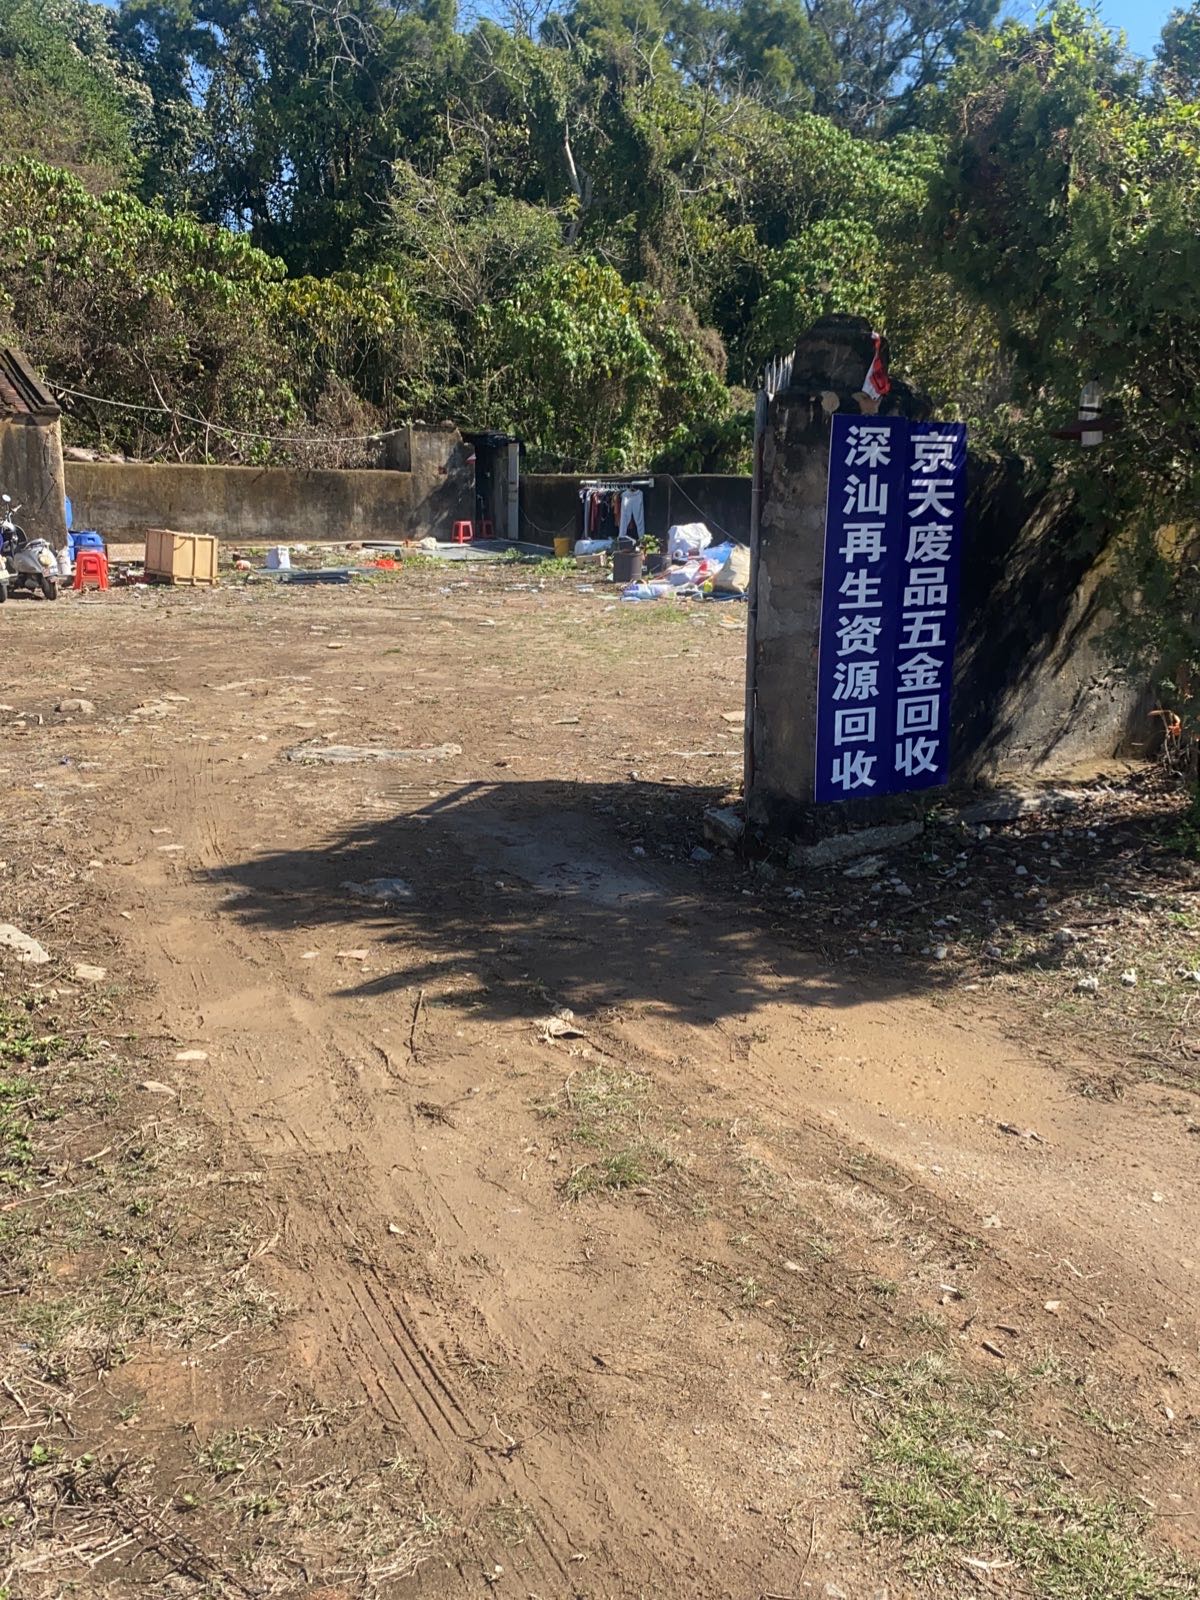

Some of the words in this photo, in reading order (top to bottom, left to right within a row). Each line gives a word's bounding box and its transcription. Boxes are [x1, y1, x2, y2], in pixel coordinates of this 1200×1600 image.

[830, 425, 891, 790] 深汕再生资源回收
[894, 431, 958, 777] 京天废品五金回收
